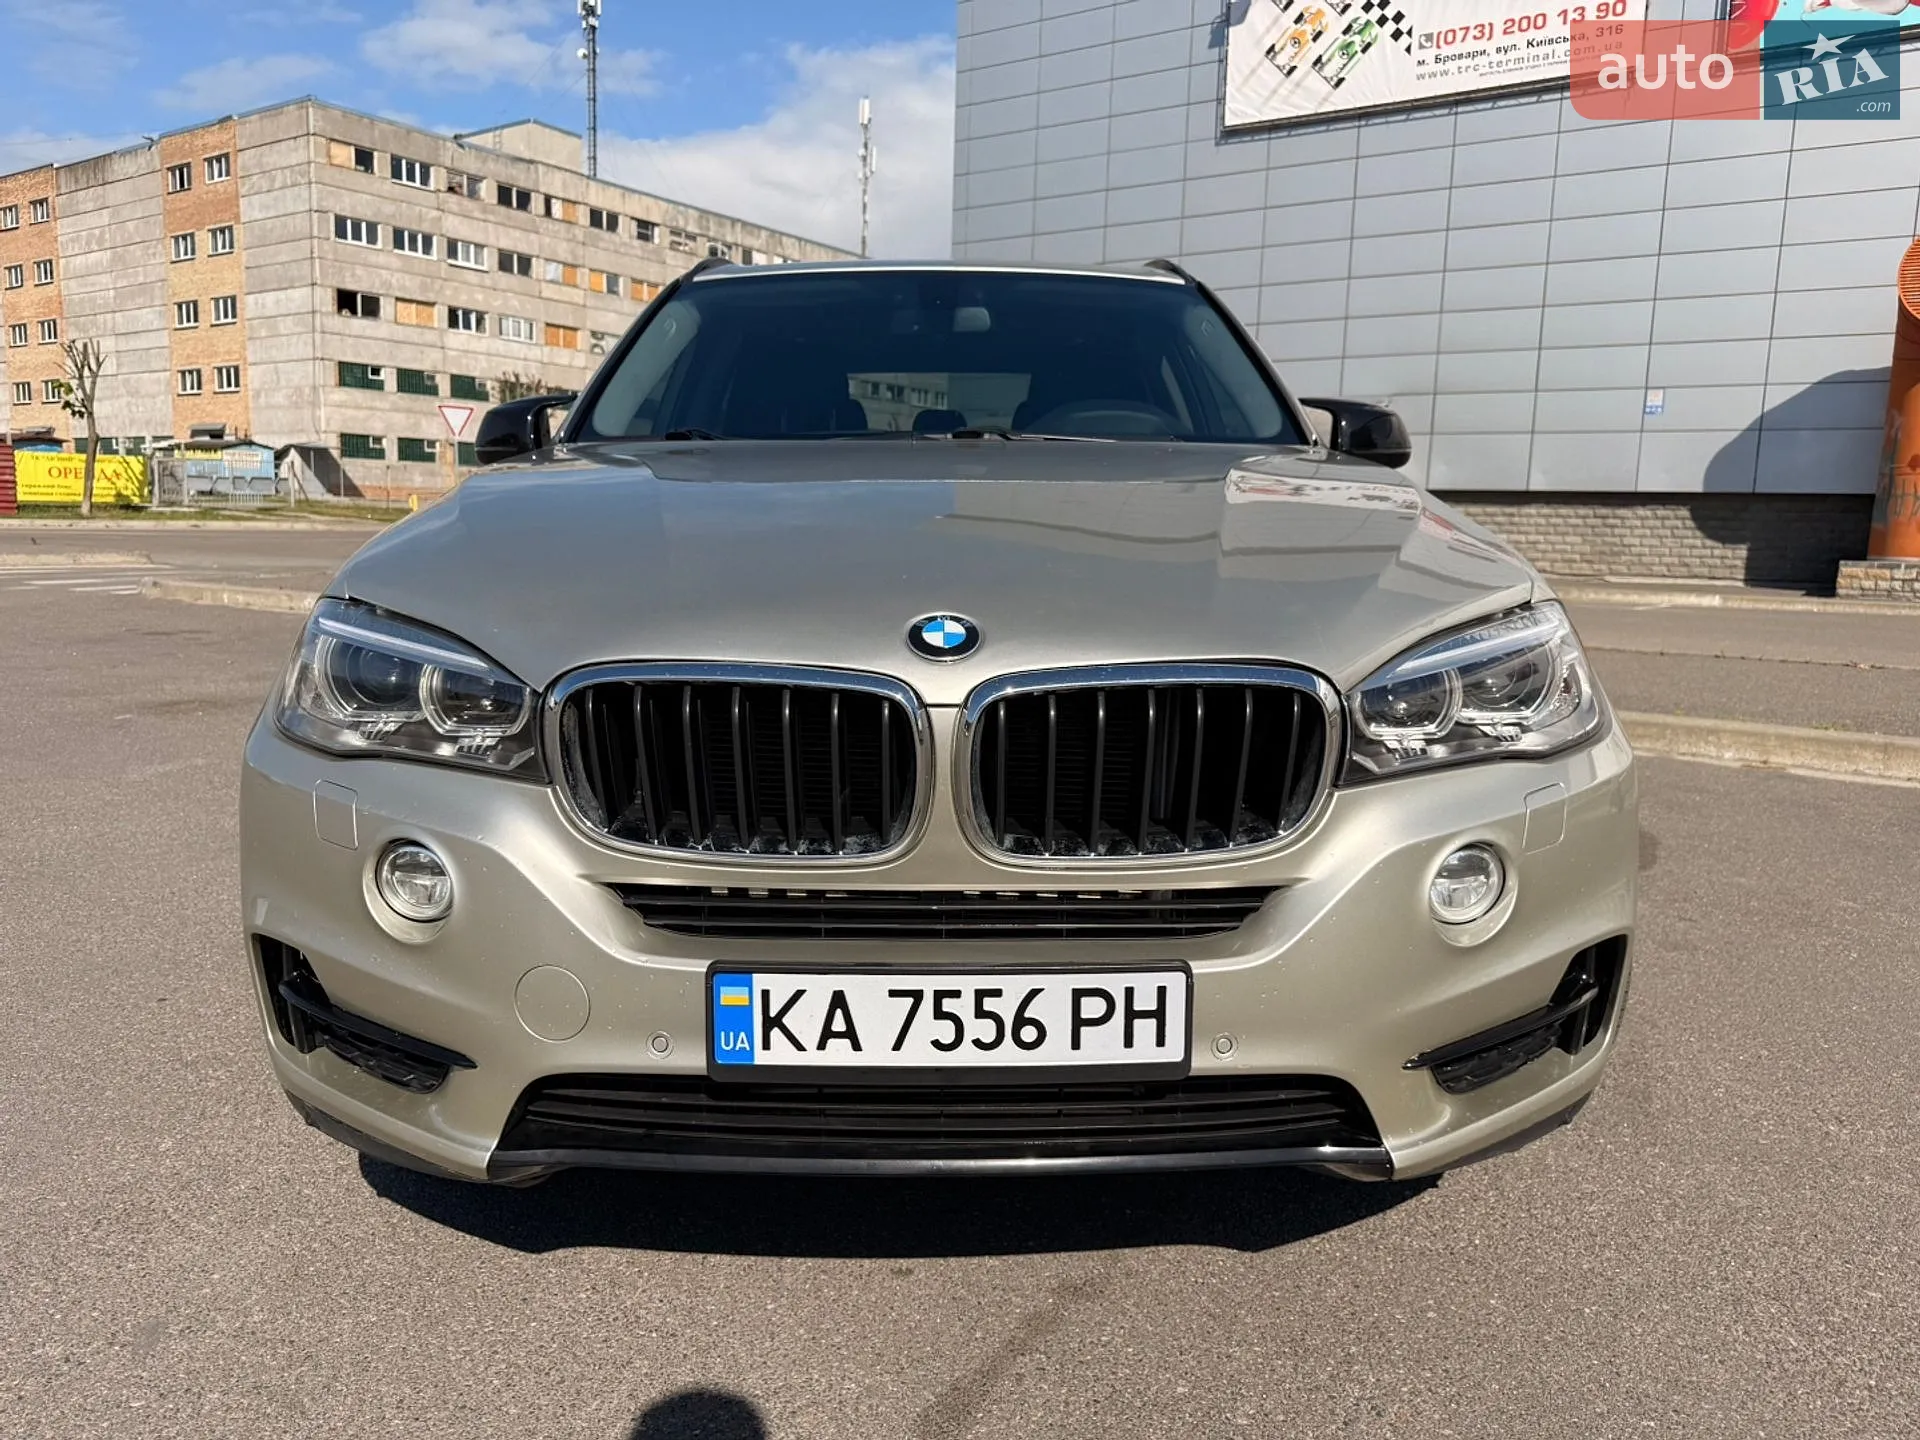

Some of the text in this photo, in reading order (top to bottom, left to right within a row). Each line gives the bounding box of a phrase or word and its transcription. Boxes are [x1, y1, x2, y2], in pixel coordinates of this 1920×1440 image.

[1434, 48, 1490, 65] Бровари,
[1496, 43, 1521, 56] вул.
[1526, 33, 1590, 49] Київська,
[1595, 23, 1624, 38] 316
[1436, 0, 1627, 49] (073) 200 13 90
[1416, 41, 1623, 81] www.trc-terminal.com.ua
[47, 465, 122, 483] ОРЕДА
[761, 985, 1167, 1052] KA 7556 PH
[720, 1030, 751, 1051] UA
